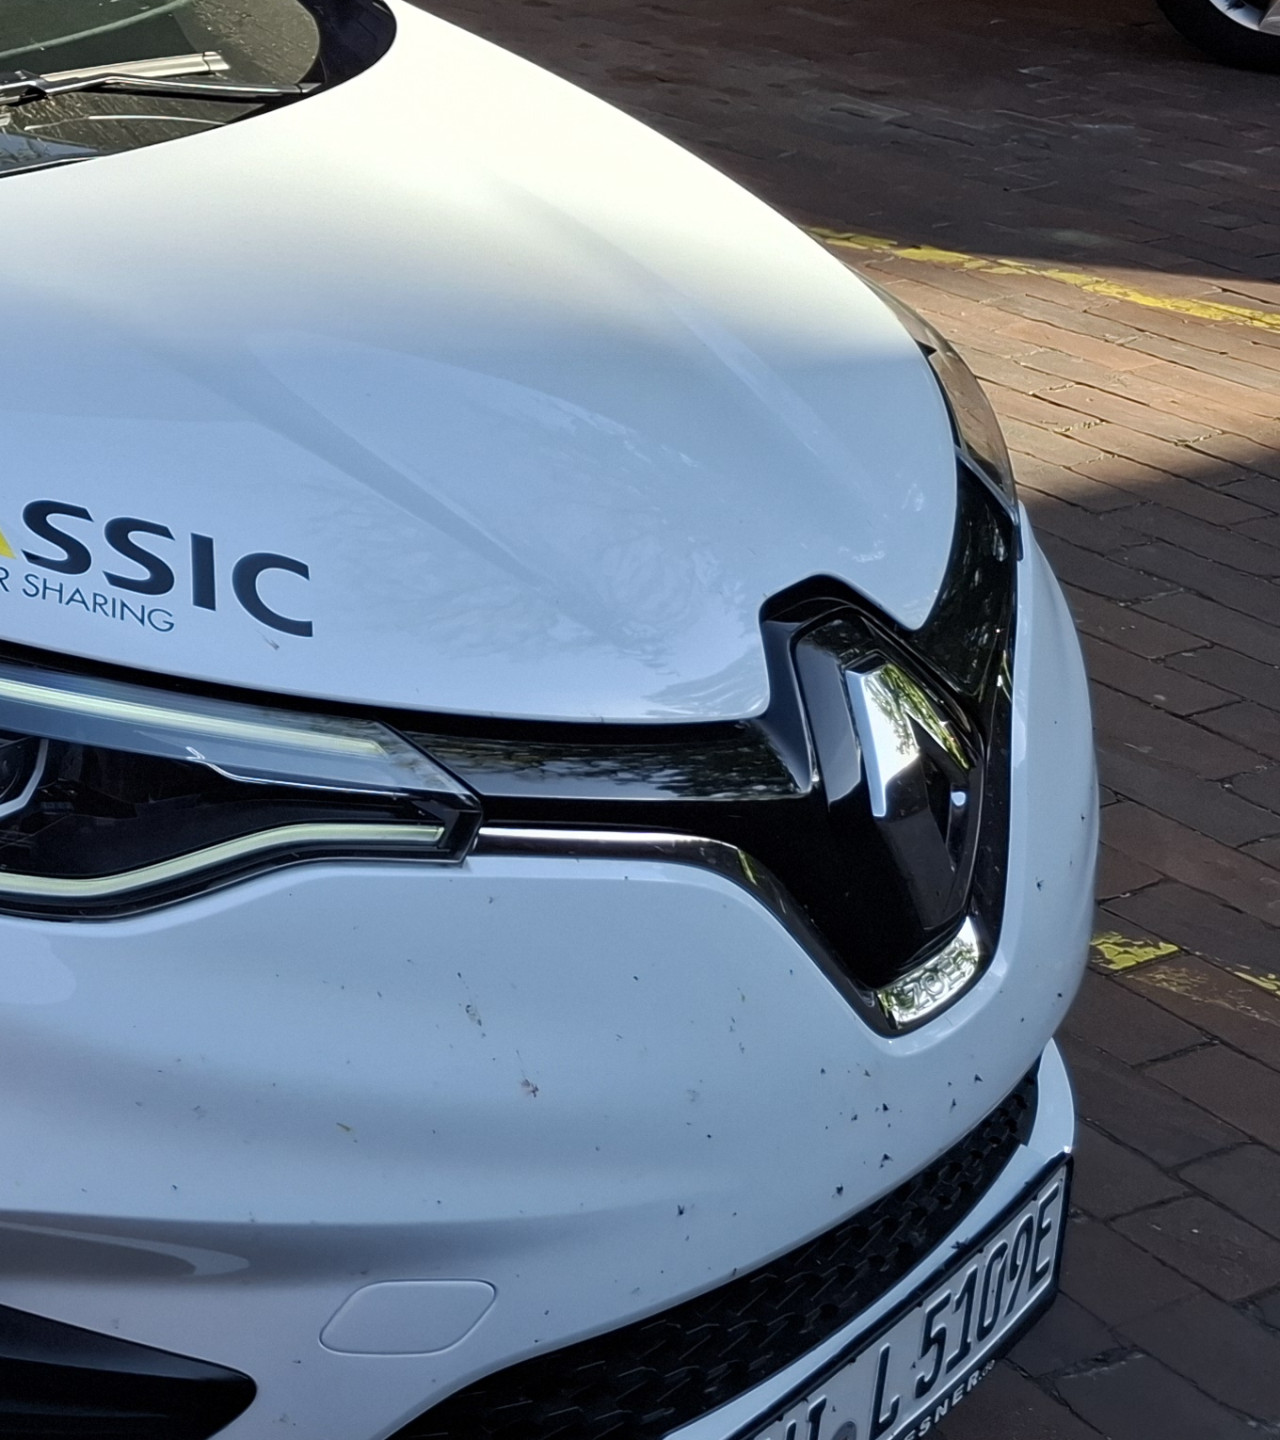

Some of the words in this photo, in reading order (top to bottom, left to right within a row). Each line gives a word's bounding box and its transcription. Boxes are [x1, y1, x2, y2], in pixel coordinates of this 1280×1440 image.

[21, 572, 176, 633] SHARING
[868, 1343, 902, 1440] L
[914, 1181, 1061, 1400] 5109E
